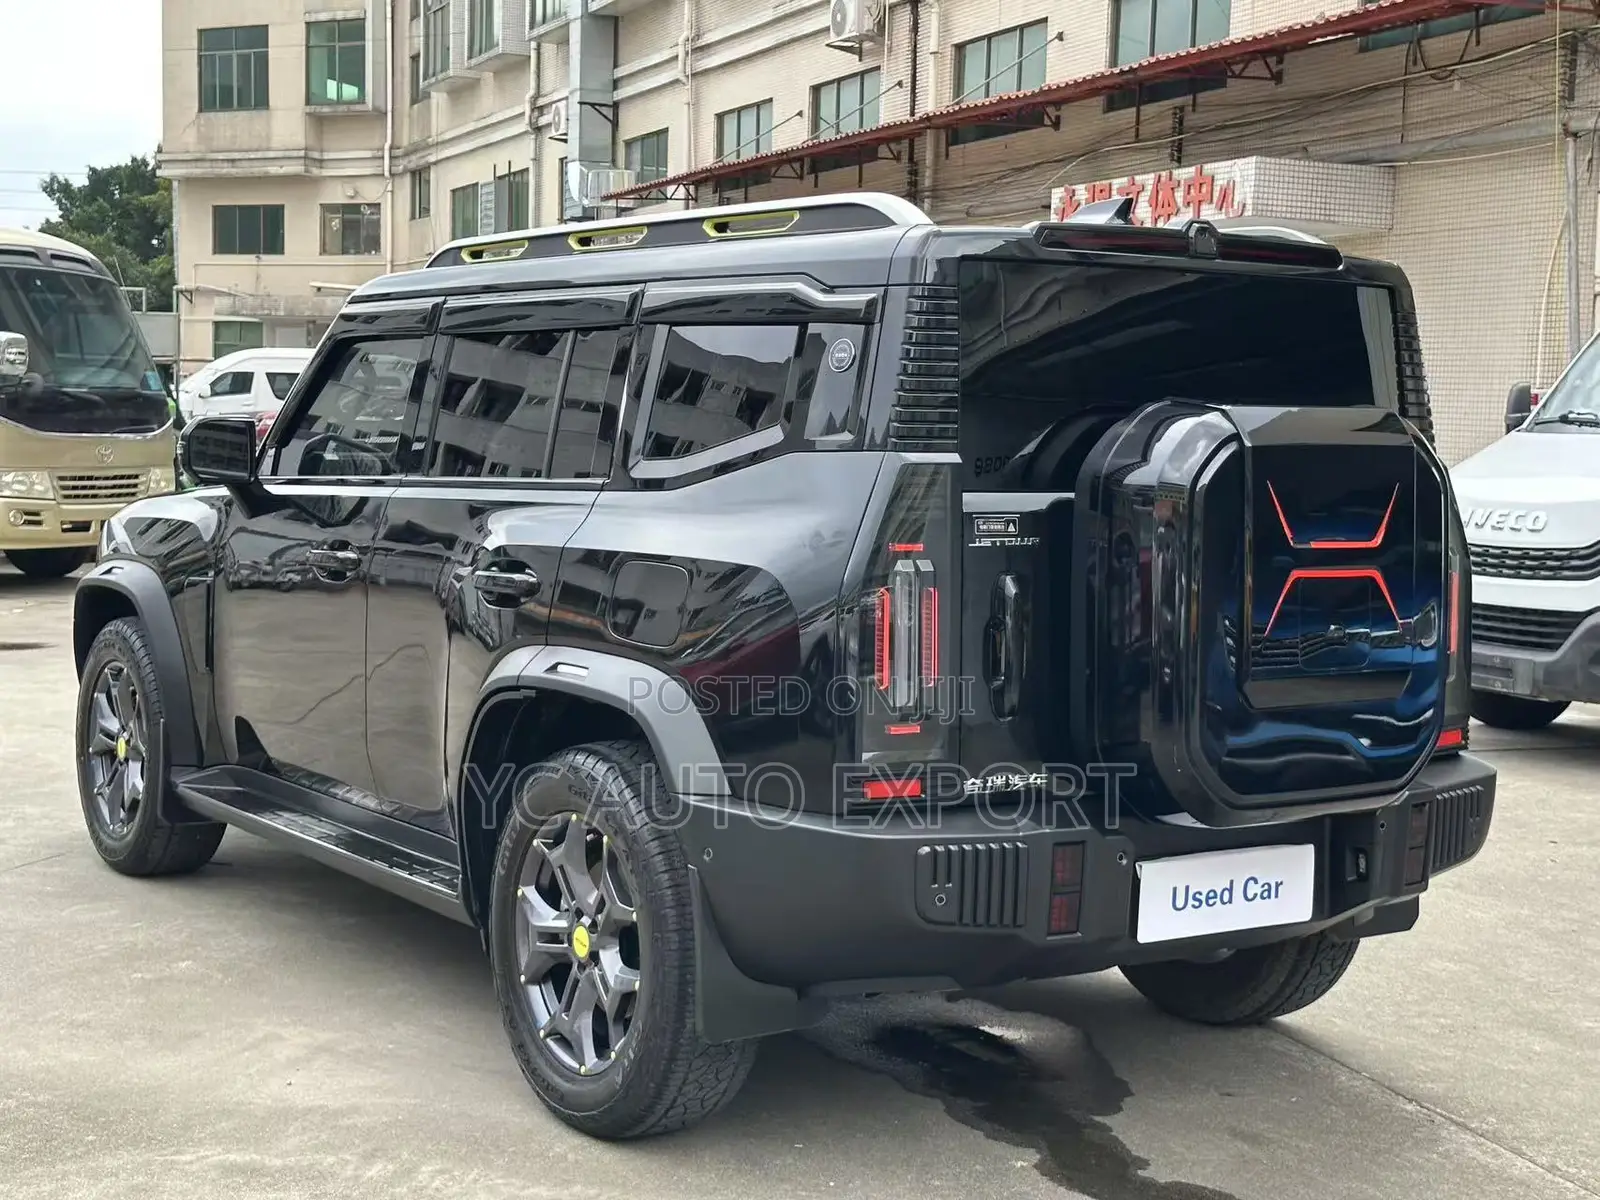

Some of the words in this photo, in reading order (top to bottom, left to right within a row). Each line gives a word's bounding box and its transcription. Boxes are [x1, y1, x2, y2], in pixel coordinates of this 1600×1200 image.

[1461, 508, 1548, 532] IVECO
[963, 773, 1049, 795] 奇瑞汽车
[1171, 879, 1234, 912] Used
[1242, 875, 1284, 903] Car
